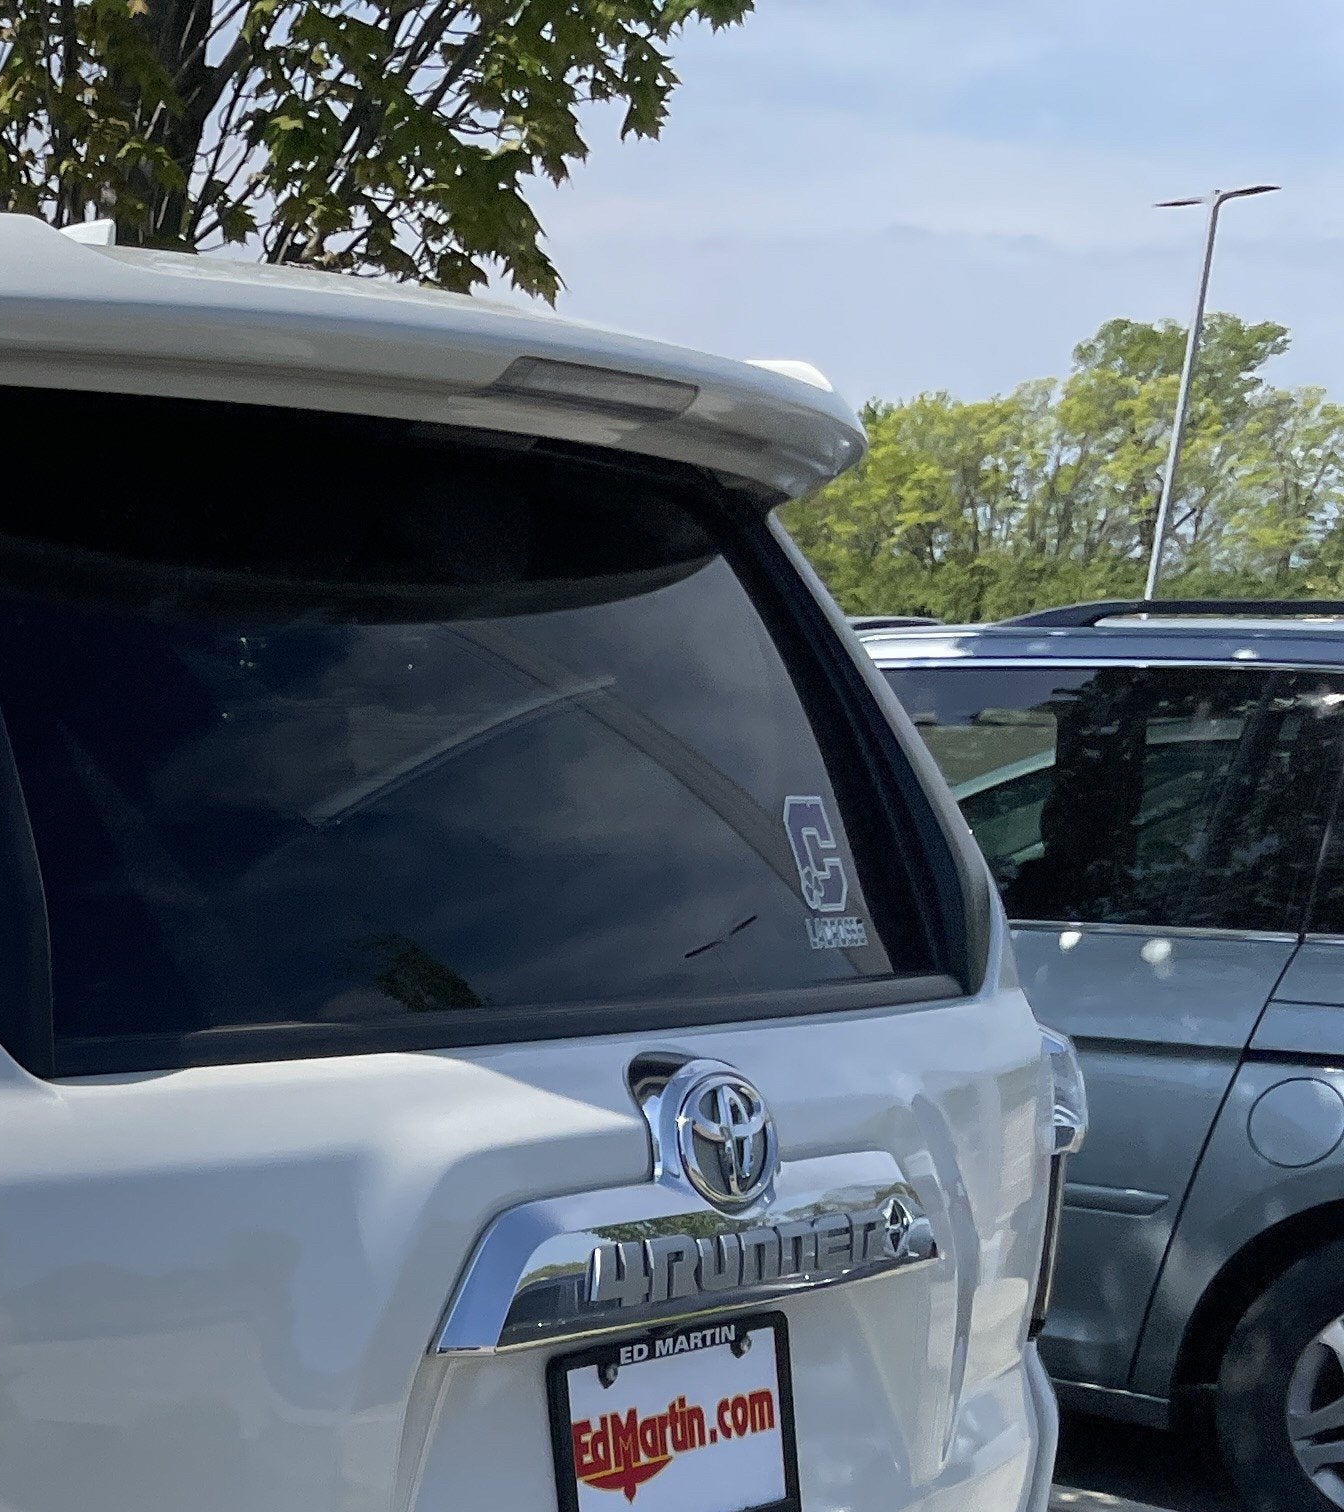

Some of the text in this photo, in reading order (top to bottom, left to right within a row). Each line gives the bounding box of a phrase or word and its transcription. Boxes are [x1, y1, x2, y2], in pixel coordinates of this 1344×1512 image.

[620, 1325, 736, 1365] ED MARTIN
[572, 1388, 776, 1481] EdMartin.com
